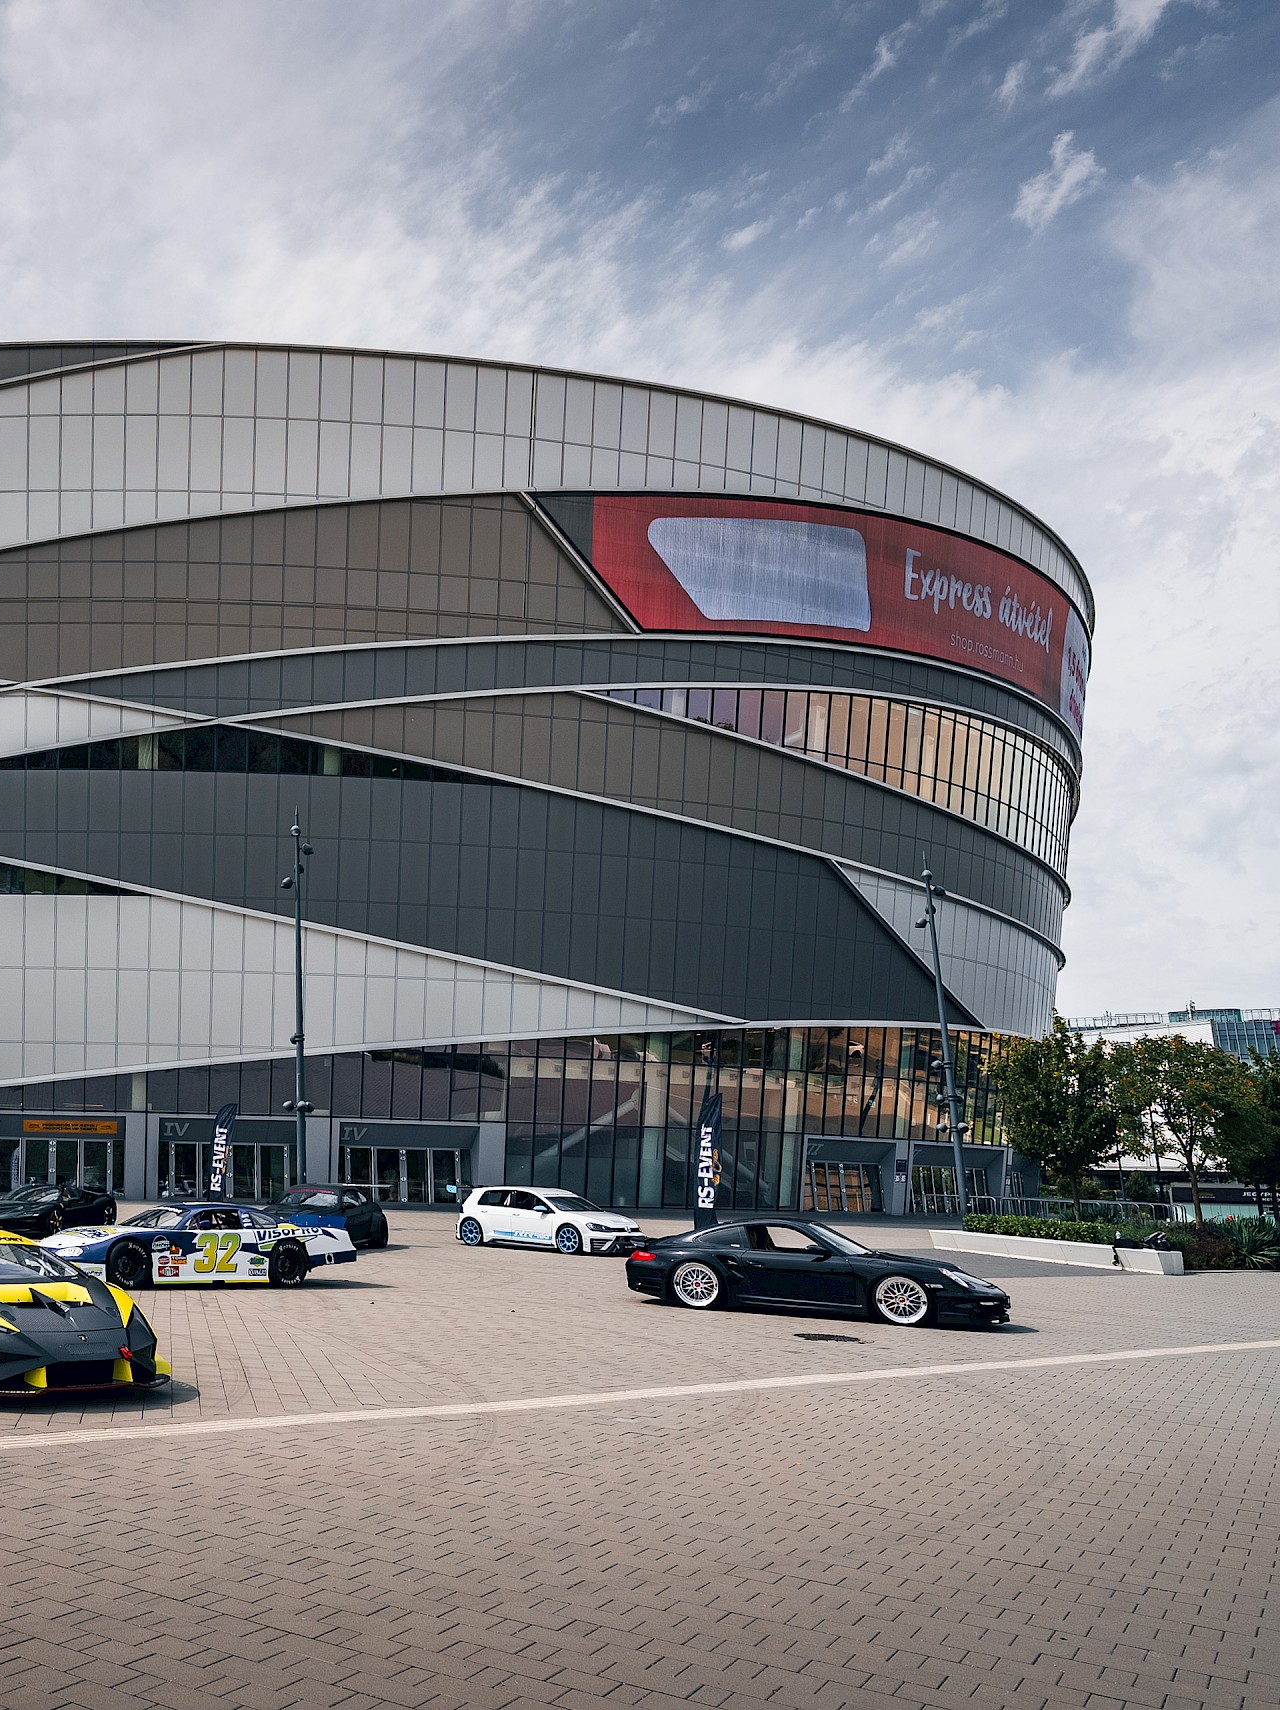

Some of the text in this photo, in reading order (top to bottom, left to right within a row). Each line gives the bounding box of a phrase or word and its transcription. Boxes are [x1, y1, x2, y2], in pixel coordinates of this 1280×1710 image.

[904, 548, 1053, 653] Express átvétel
[950, 632, 1025, 673] shop.rossmann.hu
[163, 1122, 190, 1137] IV
[341, 1127, 368, 1141] IV
[209, 1125, 228, 1192] RS-EVENT
[697, 1124, 715, 1209] RS-EVENT
[194, 1233, 241, 1273] 32
[256, 1227, 322, 1242] VISOPRO
